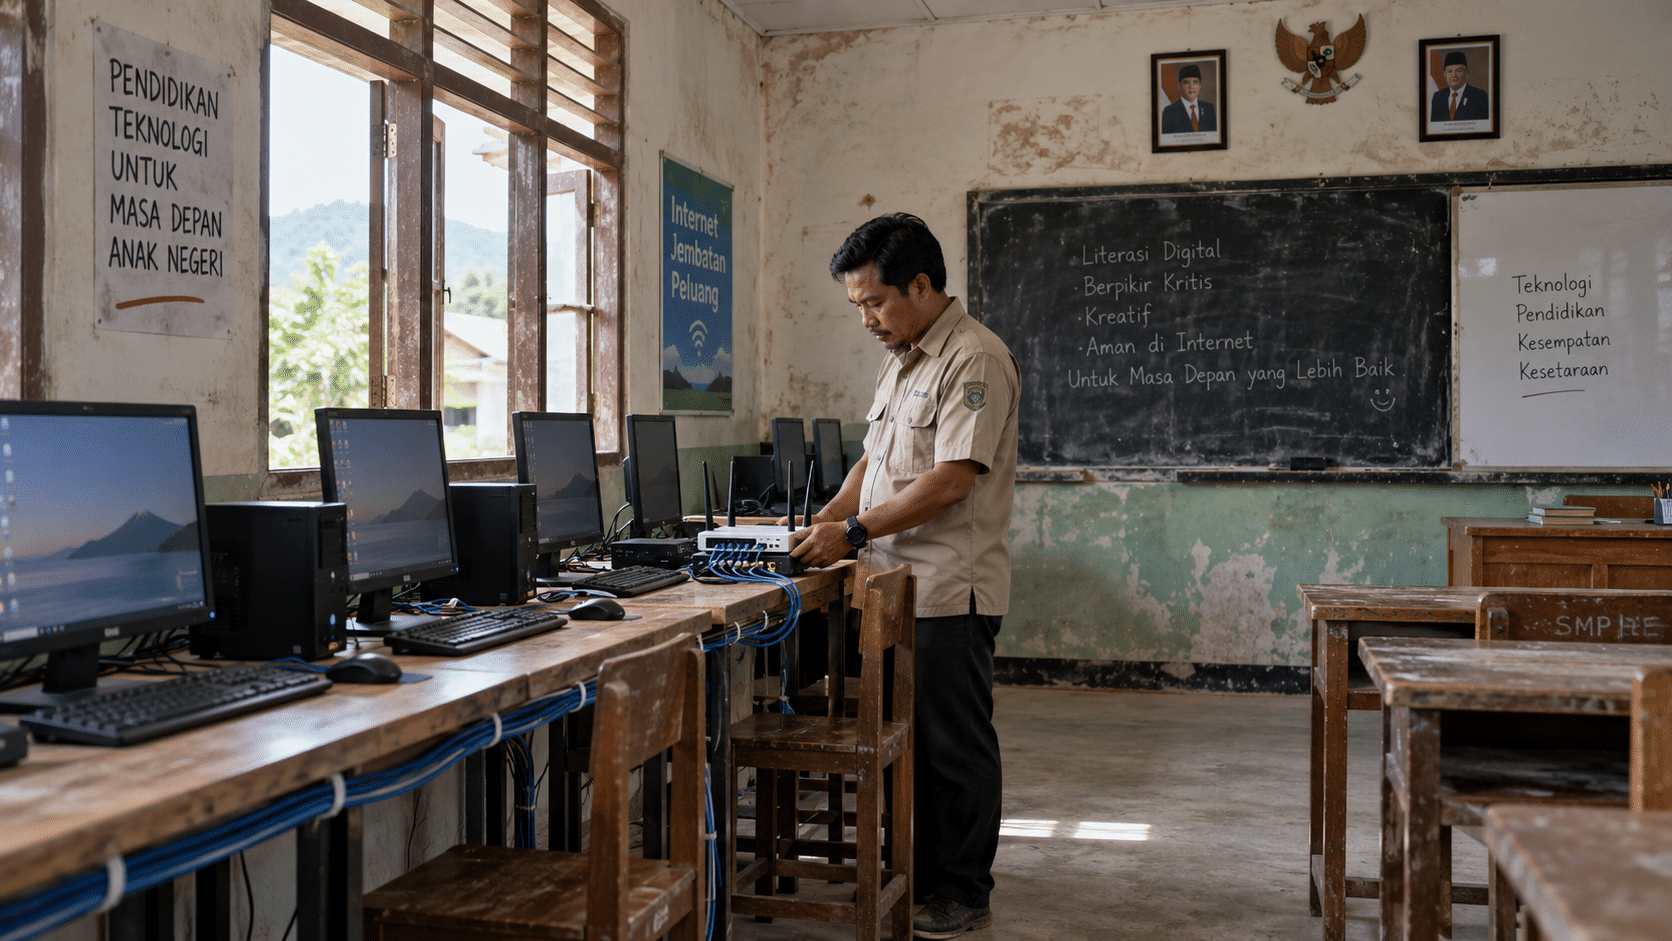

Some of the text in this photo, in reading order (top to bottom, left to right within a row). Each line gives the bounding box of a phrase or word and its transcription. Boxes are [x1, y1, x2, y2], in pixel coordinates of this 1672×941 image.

[109, 58, 219, 120] PENDIDIKAN
[109, 105, 208, 158] TEKNOLOGI
[111, 149, 178, 191] UNTUK
[110, 193, 222, 238] MASA DEPAN
[671, 195, 719, 239] Internet
[108, 236, 223, 277] ANAK NEGERI
[670, 232, 726, 274] Jembatan
[1082, 237, 1222, 268] Literasi Digital
[671, 270, 719, 314] Peluang
[1083, 272, 1213, 301] Berpikir Kritis
[1511, 272, 1592, 298] Teknologi
[1085, 303, 1152, 328] Kreatif
[1515, 301, 1605, 323] Pendidikan
[1085, 330, 1254, 357] Aman di Internet
[1518, 330, 1611, 355] Kesempatan
[1068, 356, 1395, 391] Untuk Masa Depan yang Lebih Baik
[1519, 361, 1609, 381] Kesetaraan
[1554, 615, 1612, 637] SMP
